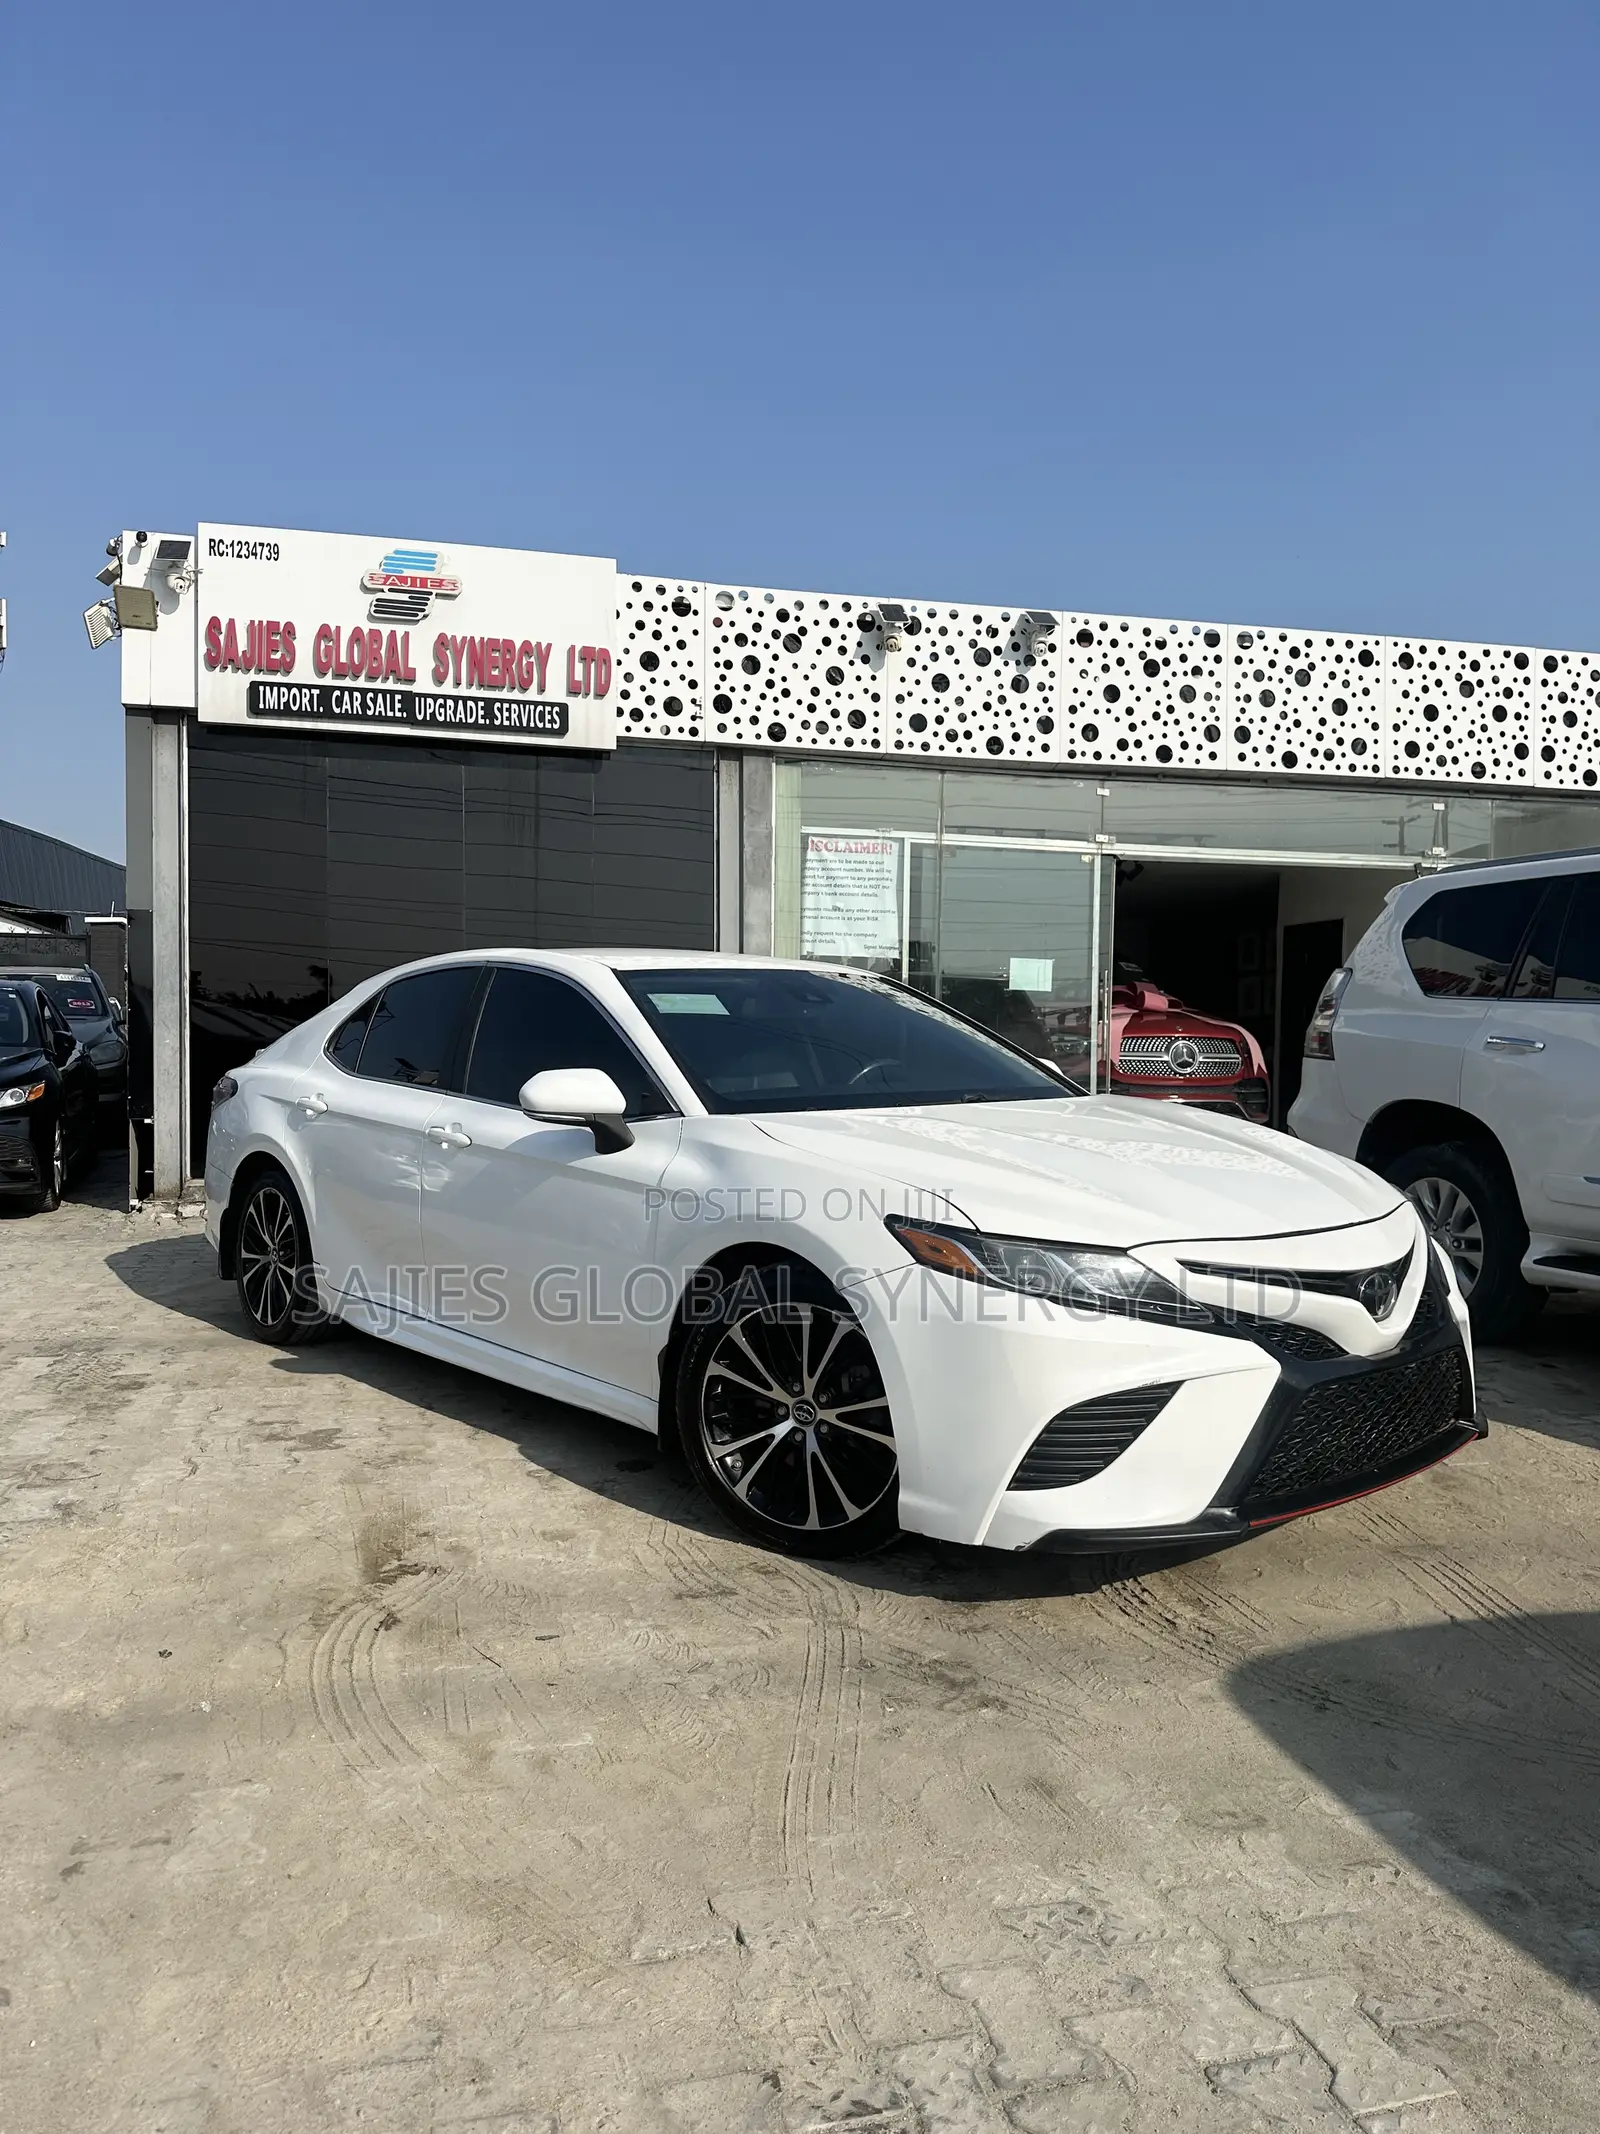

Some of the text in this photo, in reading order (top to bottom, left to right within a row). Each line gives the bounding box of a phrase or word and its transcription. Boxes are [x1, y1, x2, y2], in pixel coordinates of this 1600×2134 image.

[208, 538, 280, 561] RC:1234739
[368, 572, 460, 592] SAJIES
[205, 616, 612, 697] SAJIES GLOBAL SYNERGY LTD
[258, 685, 561, 730] IMPORT. CAR SALE. UPGRADE. SERVICES
[809, 839, 892, 855] ISCLAIMER!
